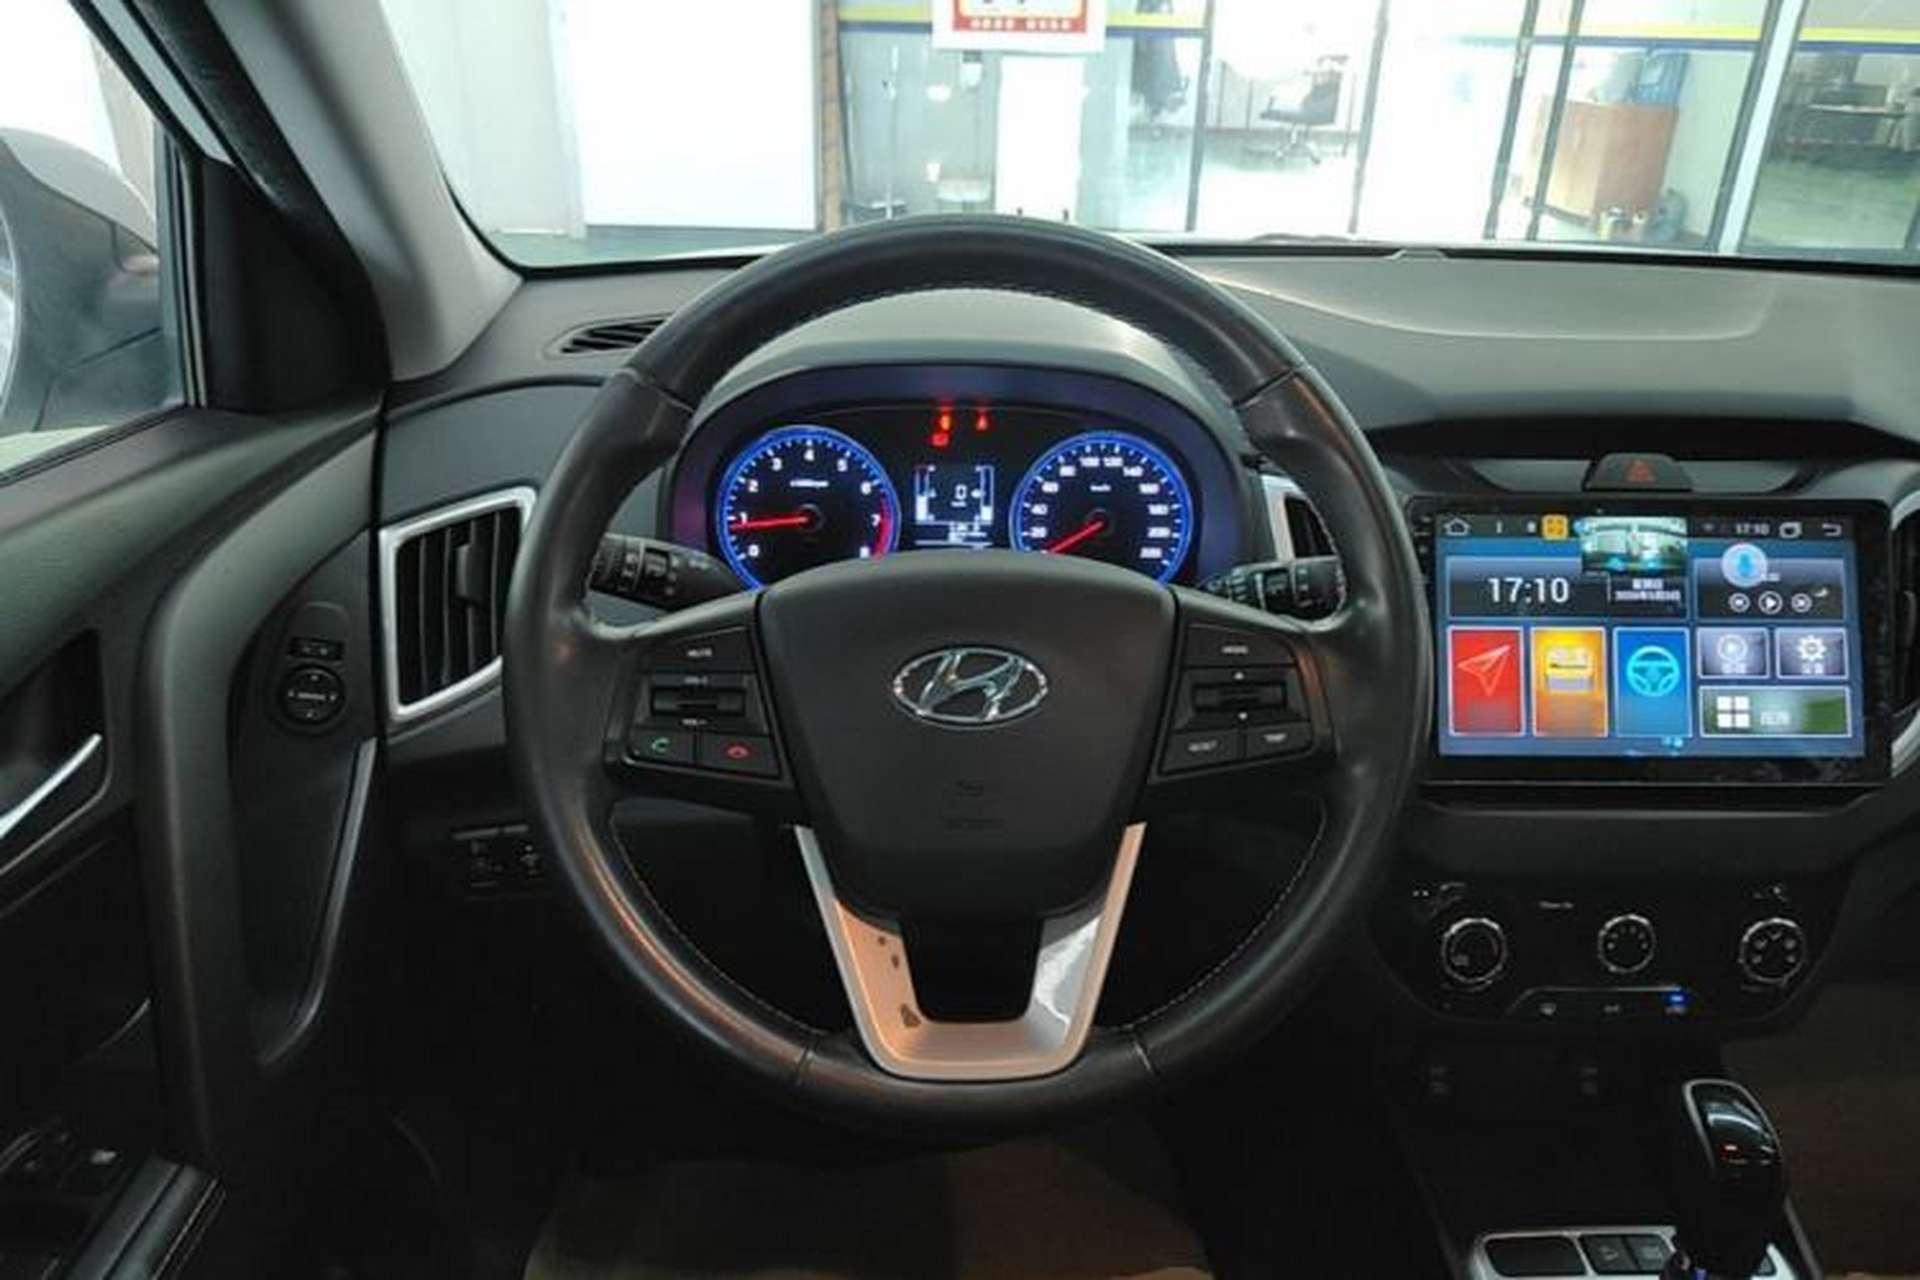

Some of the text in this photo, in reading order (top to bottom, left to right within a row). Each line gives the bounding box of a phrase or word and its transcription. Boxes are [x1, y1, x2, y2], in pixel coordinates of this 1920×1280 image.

[804, 449, 815, 461] 4
[748, 479, 759, 493] 2
[861, 481, 872, 495] 6
[955, 484, 967, 500] 0
[748, 544, 760, 557] 0
[1488, 577, 1570, 603] 17:10
